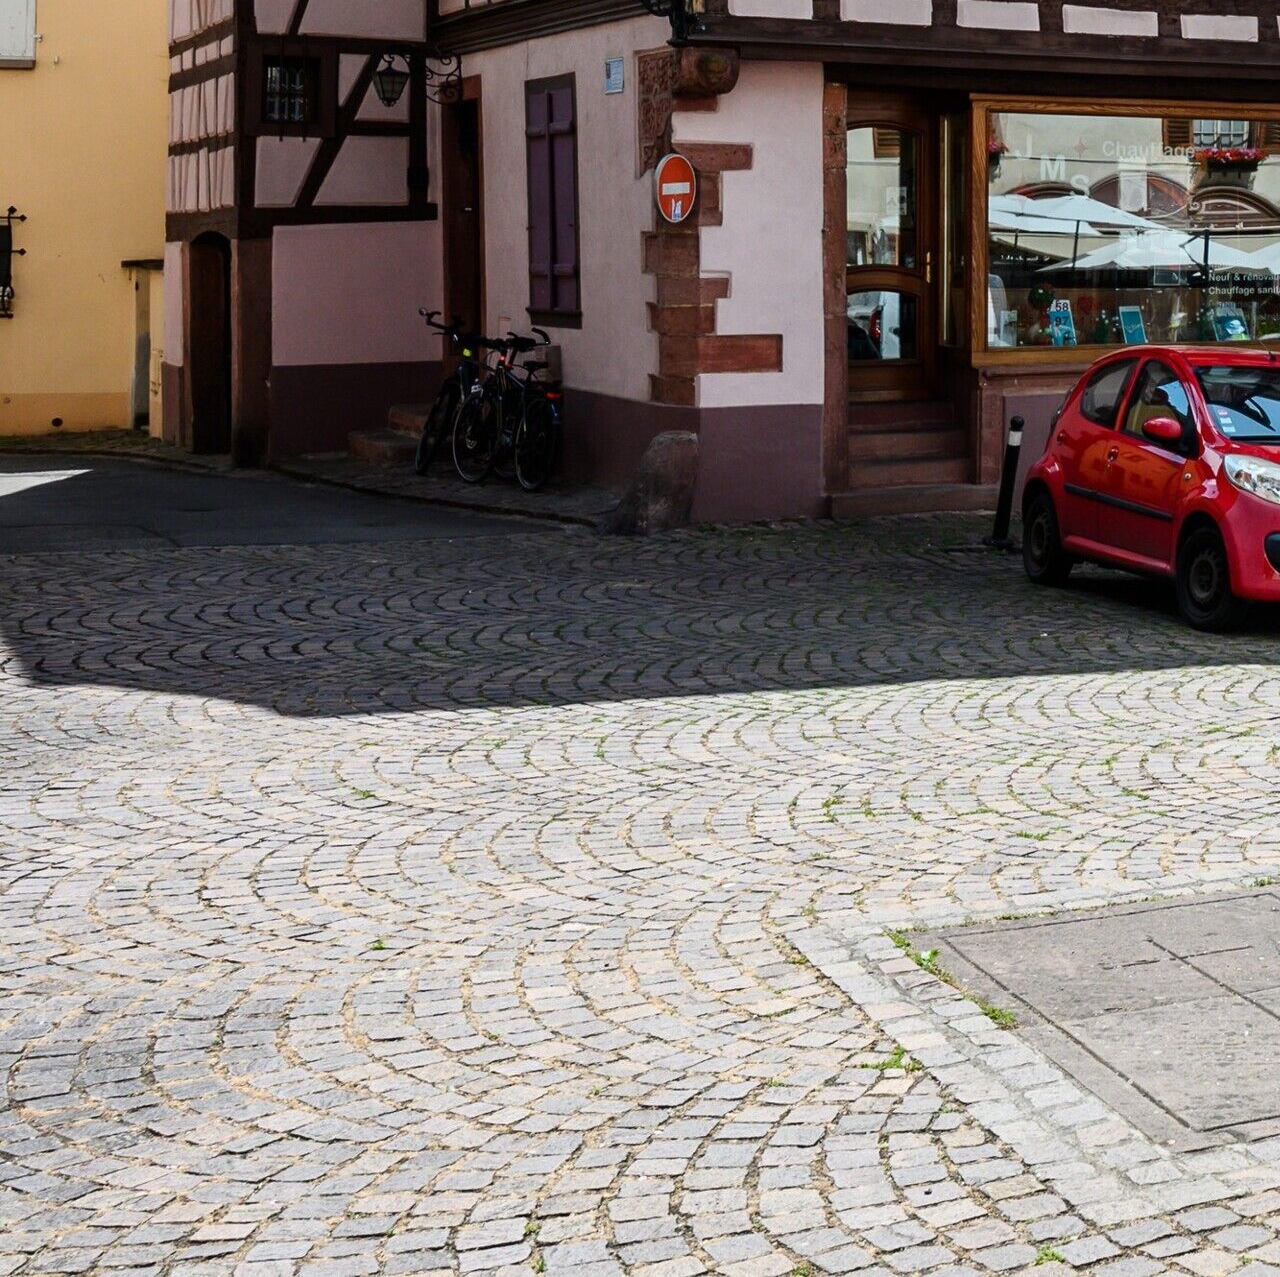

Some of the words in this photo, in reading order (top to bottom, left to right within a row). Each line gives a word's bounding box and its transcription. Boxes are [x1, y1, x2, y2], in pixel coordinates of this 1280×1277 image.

[1102, 140, 1195, 159] Chauffage
[1208, 274, 1230, 282] Neuf
[1233, 273, 1241, 282] &
[1208, 286, 1255, 296] Chauffage
